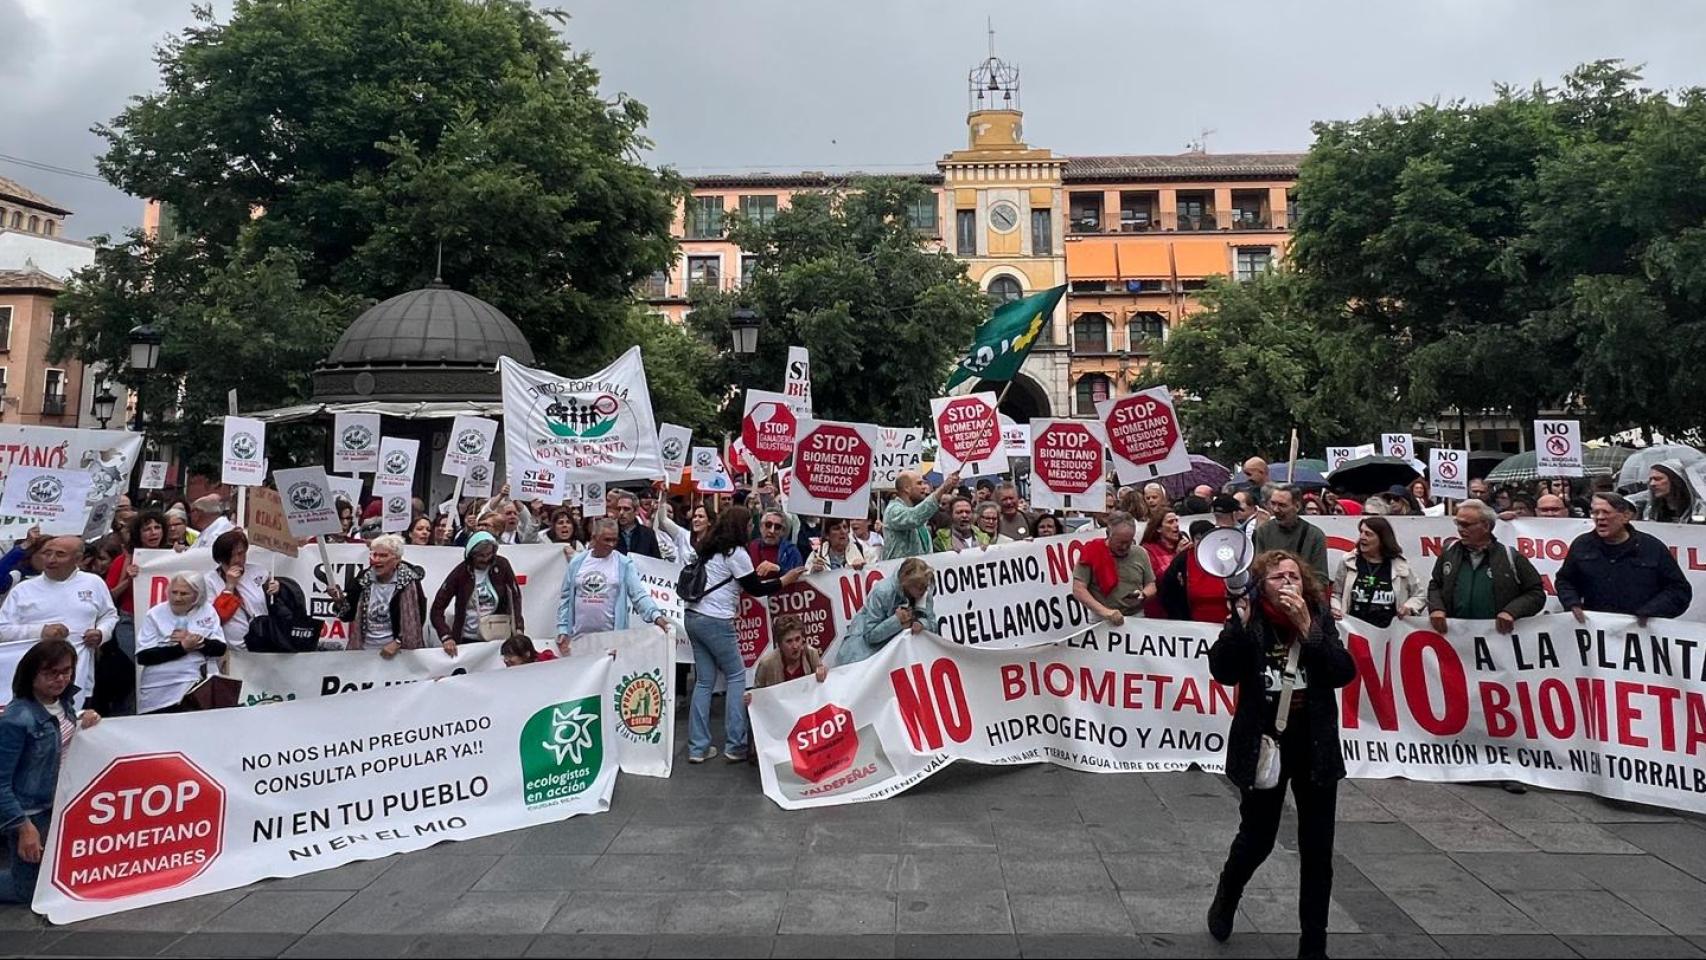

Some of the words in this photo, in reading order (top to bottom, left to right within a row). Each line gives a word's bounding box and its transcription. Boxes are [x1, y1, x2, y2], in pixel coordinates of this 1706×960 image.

[569, 381, 593, 392] POR
[598, 381, 628, 399] VILLA
[947, 404, 984, 421] STOP
[1115, 401, 1157, 423] STOP
[765, 423, 789, 434] STOP
[1112, 415, 1169, 437] BIOMETANO
[1126, 427, 1169, 443] RESIDUOS
[1543, 423, 1569, 435] NO
[537, 449, 550, 459] NO
[553, 447, 561, 456] A
[564, 445, 579, 455] LA
[582, 442, 628, 454] PLANTA
[812, 434, 860, 452] STOP
[1047, 432, 1089, 448] STOP
[1126, 438, 1165, 453] MÉDICOS
[1388, 435, 1406, 444] NO
[803, 451, 865, 466] BIOMETANO
[1040, 448, 1097, 461] BIOMETANO
[1333, 449, 1349, 457] NO
[1437, 452, 1459, 462] NO
[813, 464, 860, 476] RESIDUOS
[1048, 469, 1088, 480] MÉDICOS
[1050, 460, 1093, 470] RESIDUOS
[810, 474, 852, 486] MÉDICOS
[651, 588, 670, 602] NO
[770, 590, 816, 614] STOP
[1108, 632, 1210, 659] PLANTA
[1475, 636, 1496, 671] A
[1512, 632, 1560, 670] LA
[1342, 630, 1470, 736] NO
[890, 657, 974, 752] NO
[797, 714, 847, 750] STOP
[986, 714, 1127, 748] HIDROGENO
[1137, 727, 1151, 748] Y
[242, 753, 271, 772] NO
[278, 746, 319, 766] NOS
[324, 738, 363, 758] HAN
[369, 716, 491, 749] PREGUNTADO
[1022, 748, 1038, 760] AIRE
[1044, 747, 1069, 760] TIERRA
[1072, 753, 1078, 763] Y
[1081, 755, 1111, 769] AGUA
[1113, 761, 1144, 770] LIBRE
[1147, 762, 1159, 770] DE
[1344, 740, 1360, 761] NI
[1368, 741, 1389, 763] EN
[1397, 740, 1478, 765] CARRIÓN
[1486, 746, 1510, 766] DE
[1518, 749, 1562, 770] CVA.
[1570, 750, 1588, 771] NI
[254, 765, 357, 796] CONSULTA
[362, 747, 447, 776] POPULAR
[451, 740, 483, 758] YA!!
[526, 767, 590, 790] ecologistas
[801, 763, 877, 796] VALDEPEÑAS
[527, 792, 543, 802] en
[547, 780, 586, 797] acción
[88, 780, 200, 825] STOP
[252, 816, 283, 843] NI
[293, 808, 330, 835] EN
[338, 799, 374, 825] TU
[383, 775, 488, 817] PUEBLO
[71, 820, 211, 858] BIOMETANO
[288, 844, 321, 861] NI
[329, 834, 369, 850] EN
[376, 828, 410, 841] EL
[414, 816, 468, 836] MIO
[71, 849, 206, 886] MANZANARES
